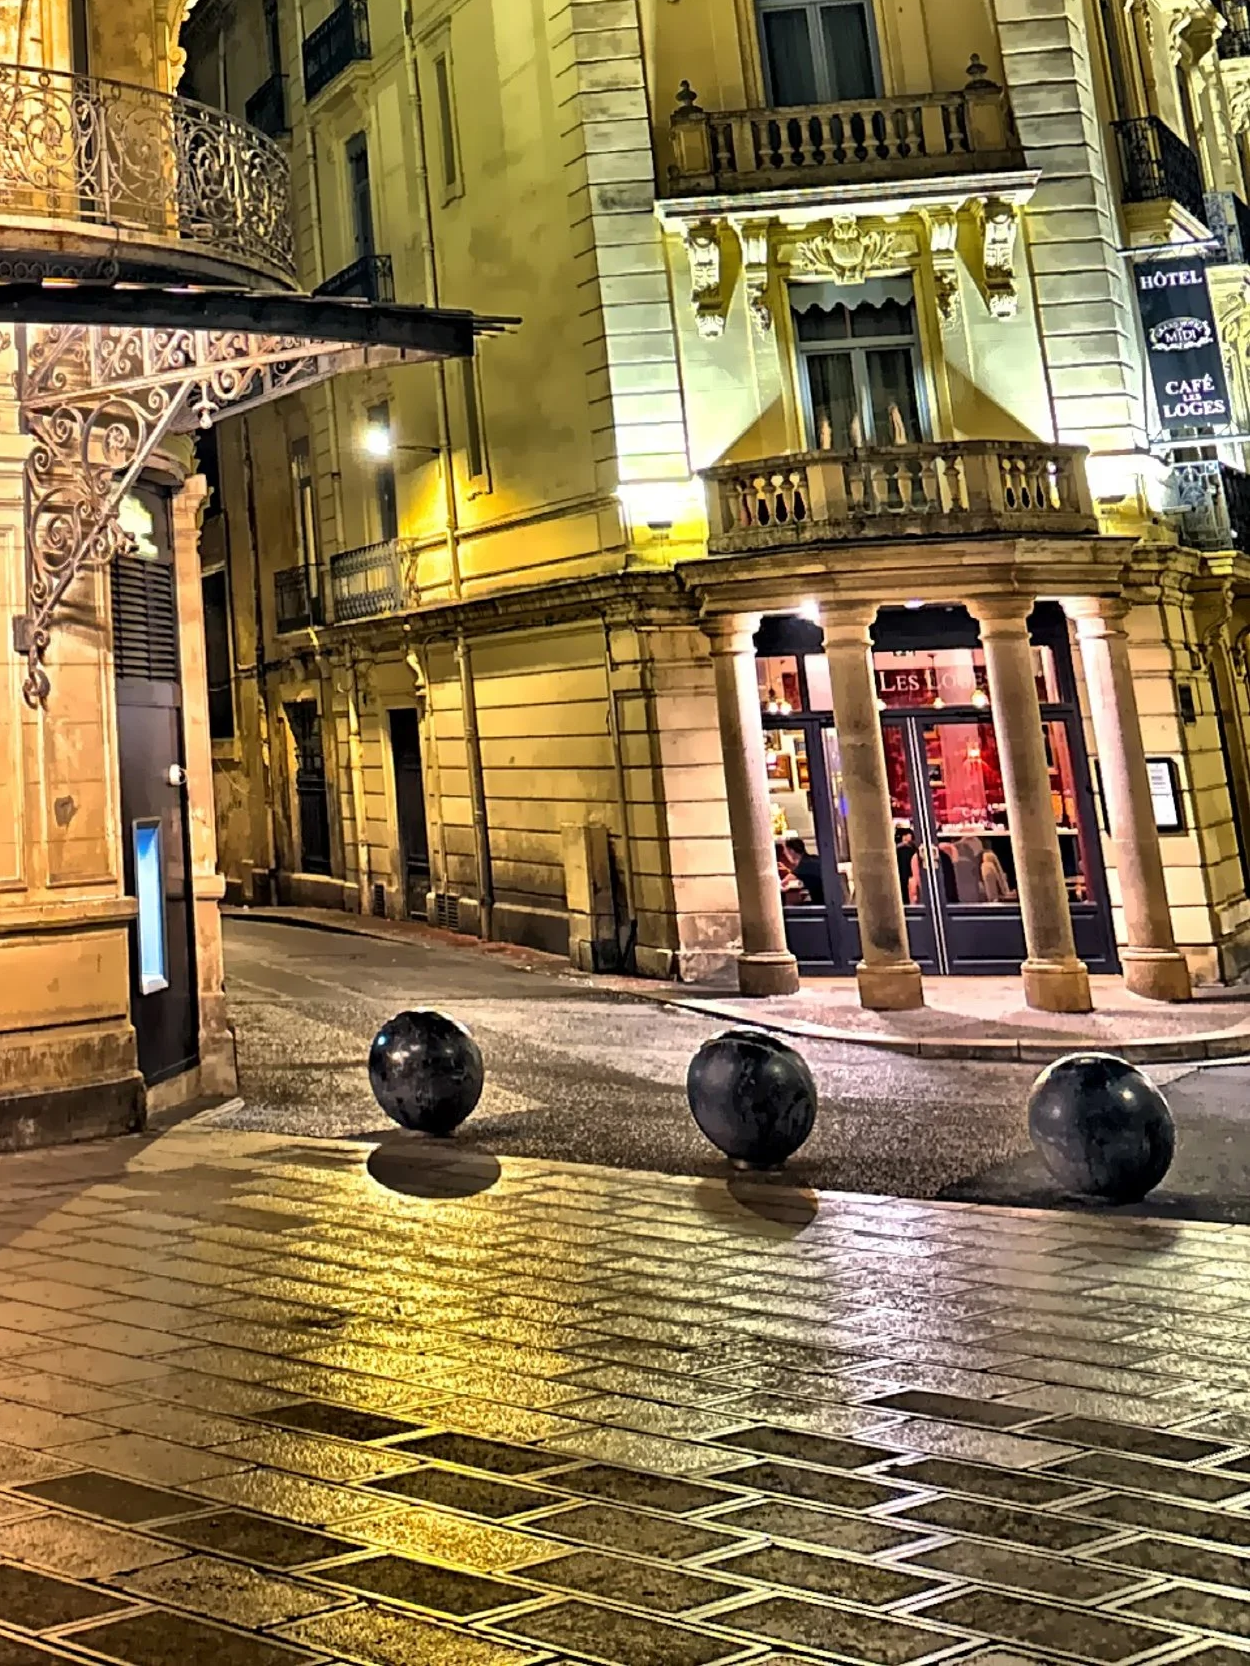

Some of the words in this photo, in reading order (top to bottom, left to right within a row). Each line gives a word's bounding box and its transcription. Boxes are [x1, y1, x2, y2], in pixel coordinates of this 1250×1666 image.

[1140, 270, 1203, 290] HÔTEL
[1165, 330, 1197, 343] MIDI
[1165, 373, 1215, 395] CAFÉ
[1163, 399, 1226, 418] LOGES
[879, 671, 920, 692] LES
[926, 669, 989, 690] LOE
